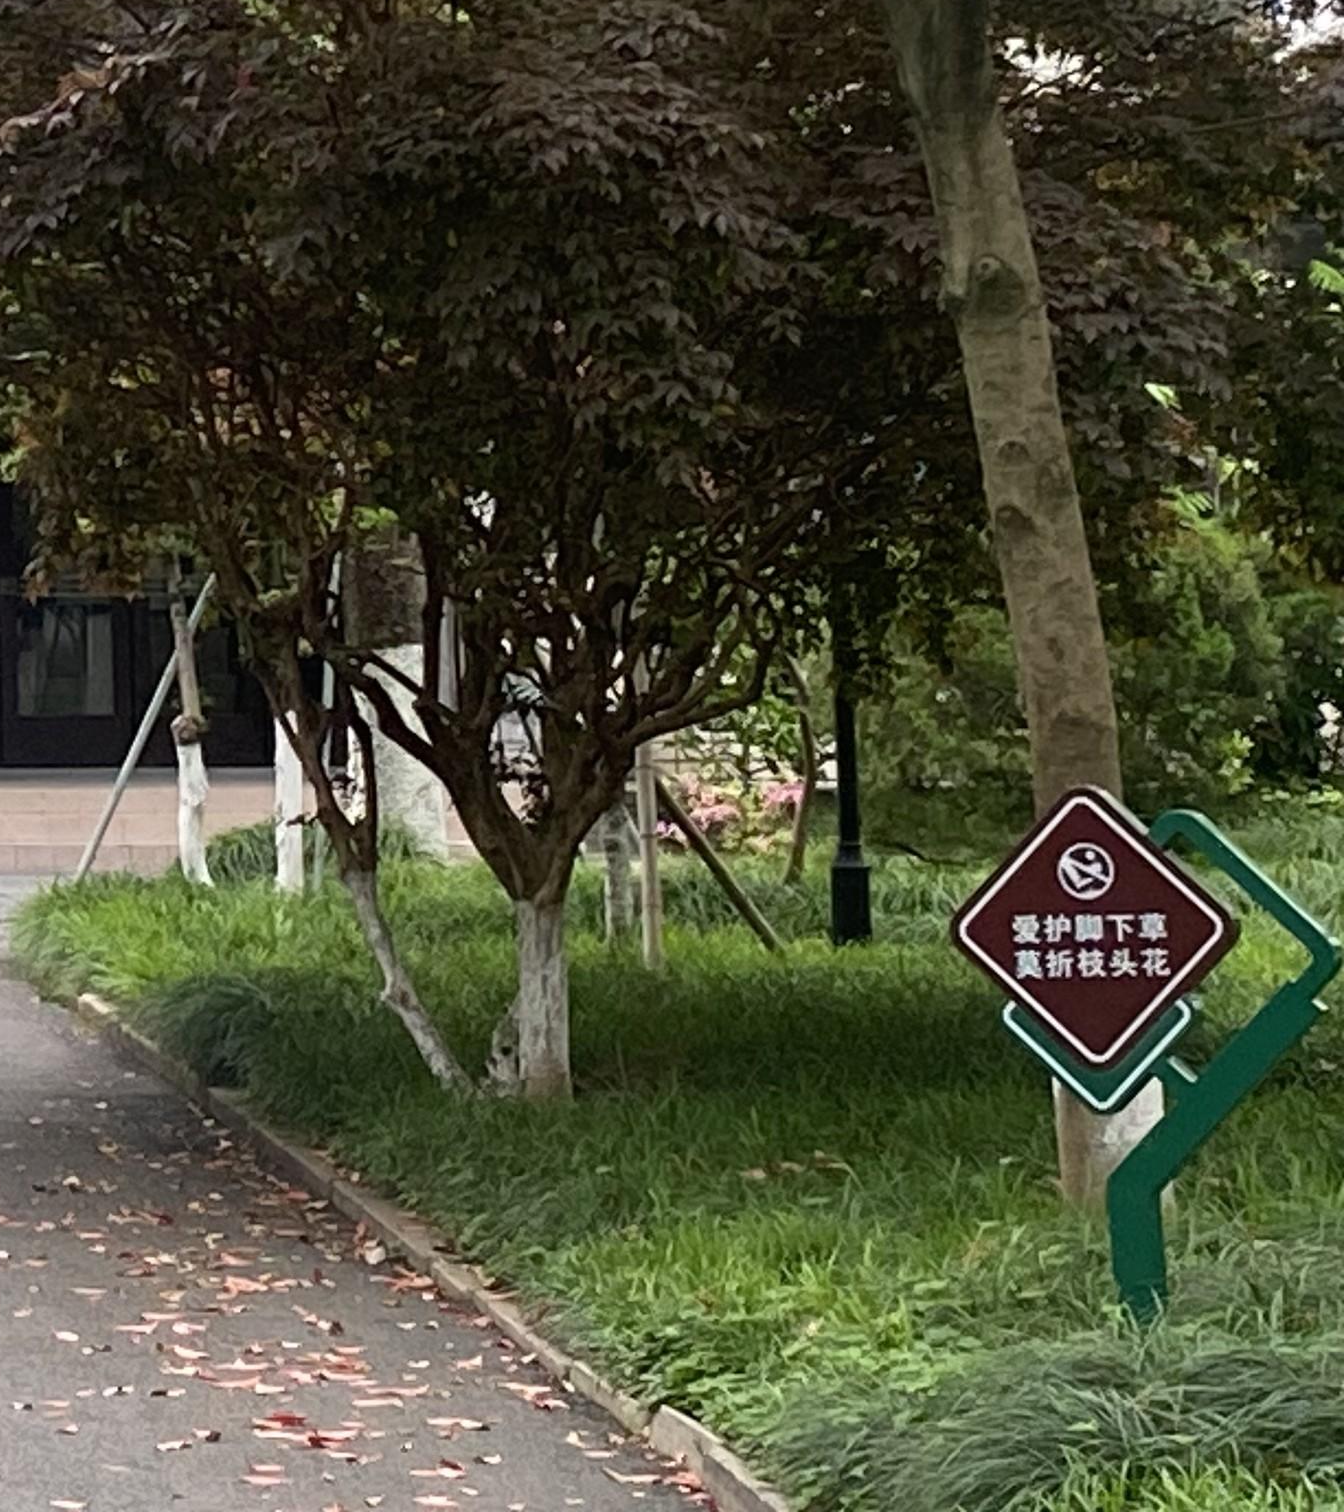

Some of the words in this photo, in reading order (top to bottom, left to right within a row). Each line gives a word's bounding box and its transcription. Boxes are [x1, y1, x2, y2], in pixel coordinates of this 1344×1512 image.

[1012, 913, 1168, 944] 爱护脚下草
[1014, 948, 1171, 979] 莫折枝头花
